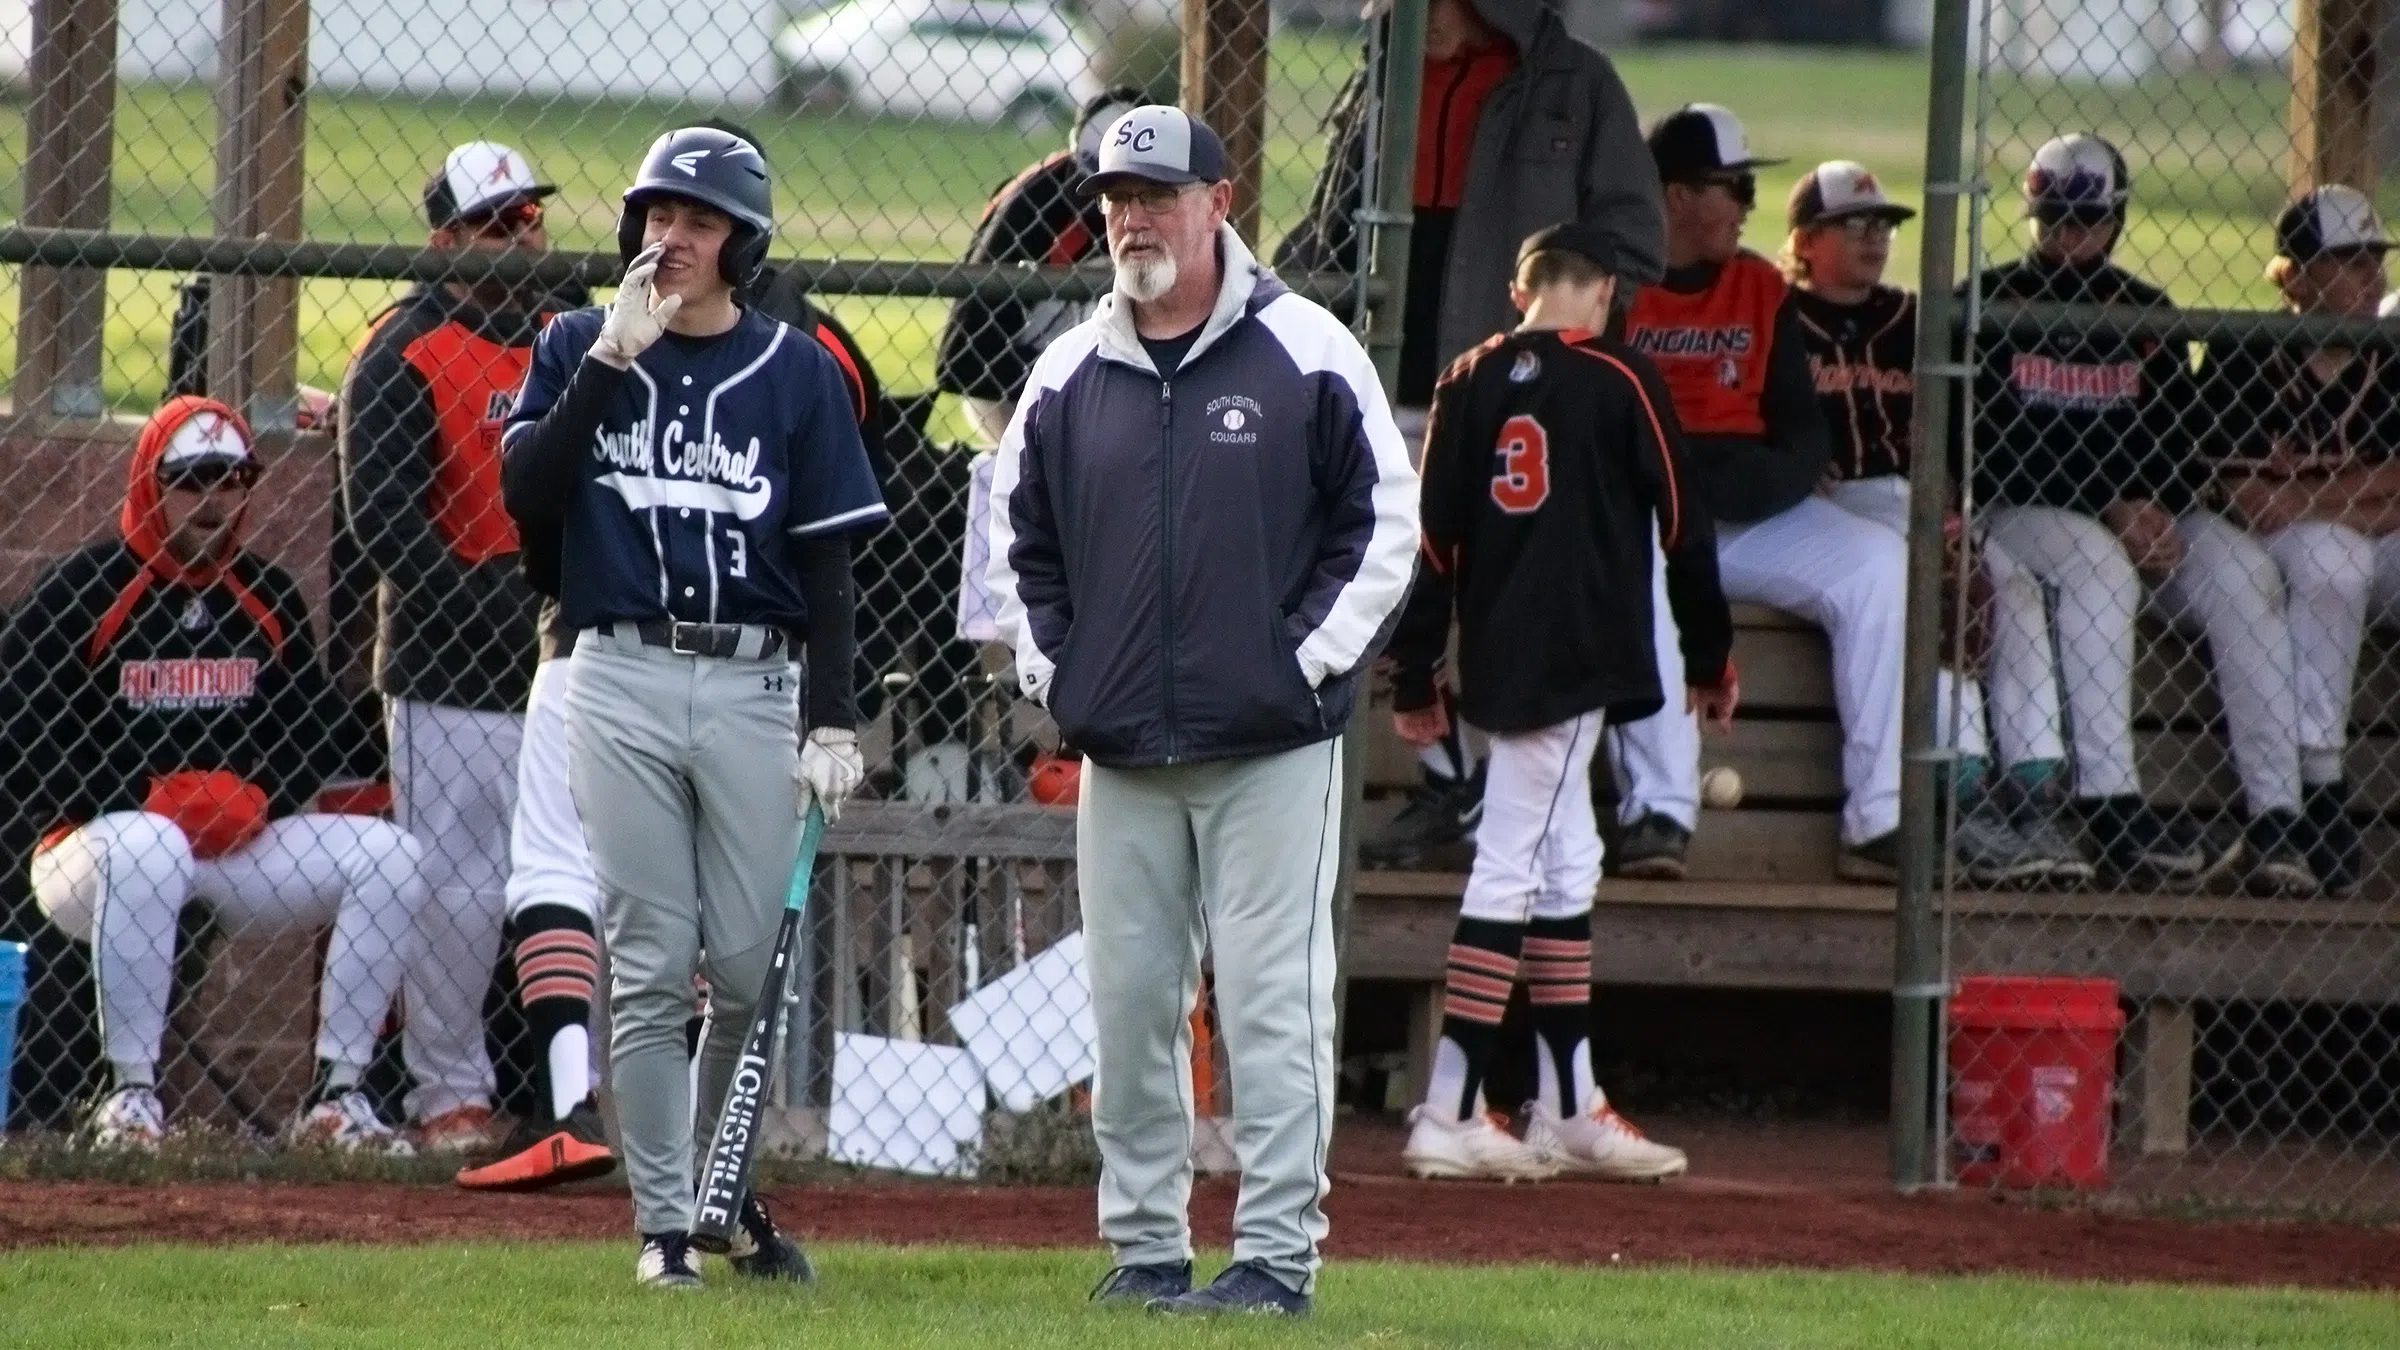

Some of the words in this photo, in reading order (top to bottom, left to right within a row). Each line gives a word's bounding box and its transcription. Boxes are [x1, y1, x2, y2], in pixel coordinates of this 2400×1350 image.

[1113, 119, 1156, 153] SC
[1627, 325, 1752, 355] INDIANS
[486, 391, 519, 421] IN
[1206, 395, 1231, 415] SOUTH
[1231, 395, 1262, 417] CENTRAL
[592, 419, 654, 471] South
[662, 420, 760, 489] Central
[1210, 431, 1257, 444] COUGARS
[1491, 414, 1550, 513] 3
[726, 529, 747, 578] 3
[699, 1055, 766, 1226] LOUISVILLE
